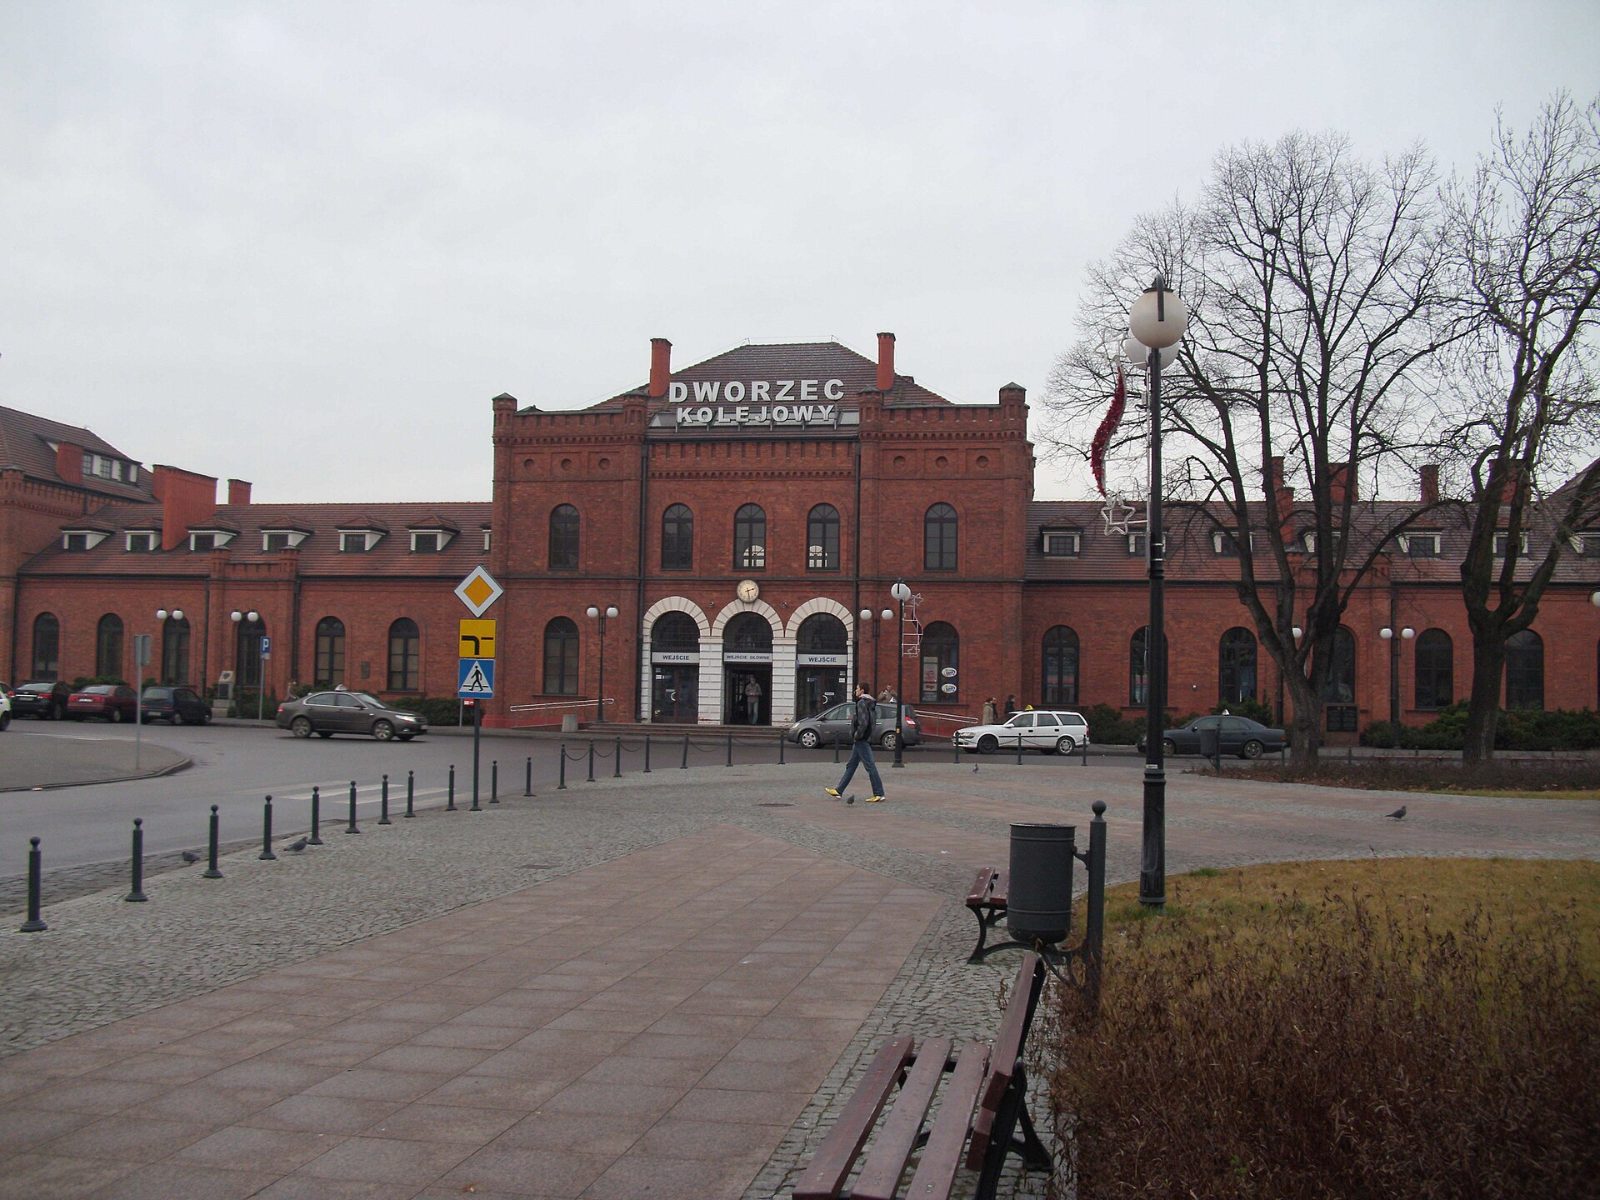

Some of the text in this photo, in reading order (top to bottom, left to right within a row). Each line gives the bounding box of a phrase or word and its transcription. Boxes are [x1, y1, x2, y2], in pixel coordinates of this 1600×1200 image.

[669, 379, 845, 403] DWORZEC
[676, 405, 834, 423] KOLEJOWY
[263, 638, 269, 651] P
[808, 655, 837, 663] WEJŚCIE
